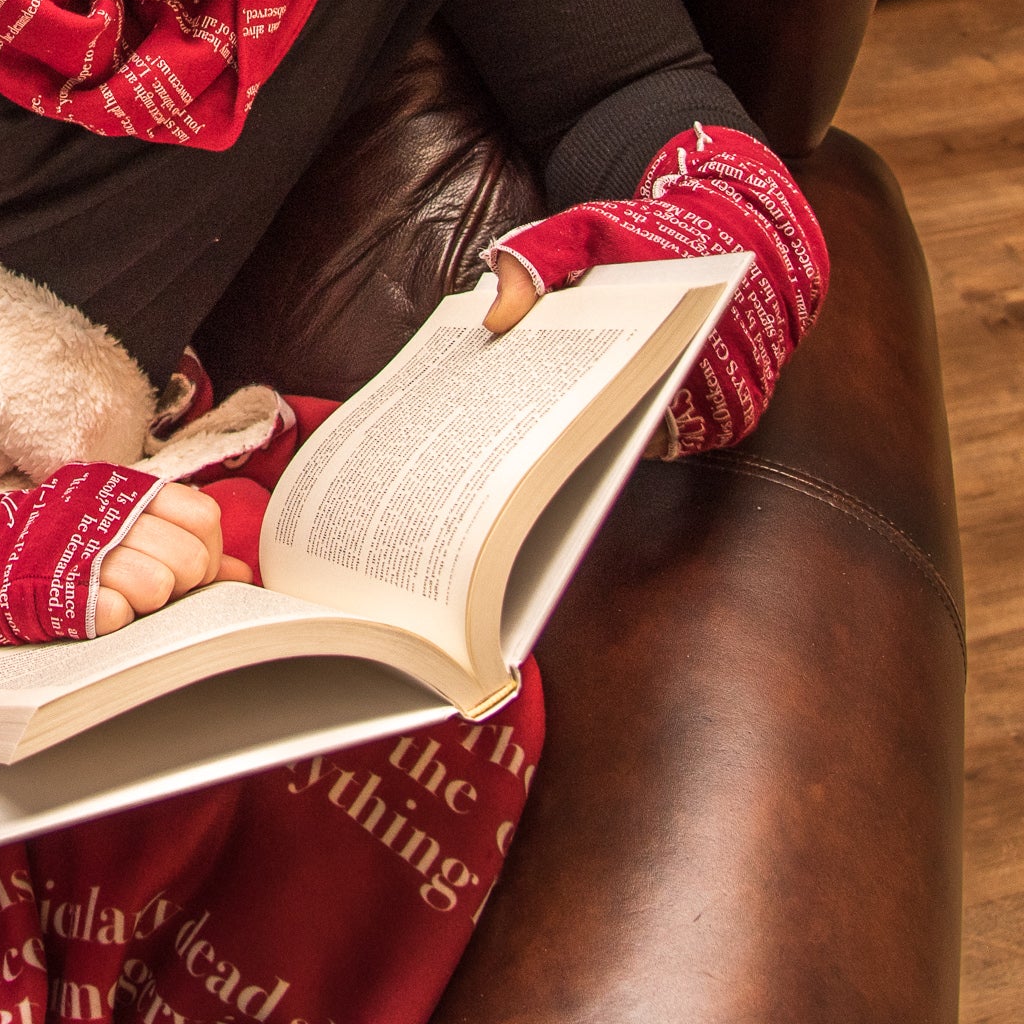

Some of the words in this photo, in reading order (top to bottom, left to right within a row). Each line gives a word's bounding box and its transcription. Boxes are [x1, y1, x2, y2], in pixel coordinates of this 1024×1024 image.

[684, 211, 713, 230] Old
[620, 221, 680, 253] whatever
[78, 514, 98, 533] he
[97, 507, 121, 534] that
[48, 533, 85, 612] demanded,
[388, 736, 478, 815] the
[174, 909, 291, 1024] dead
